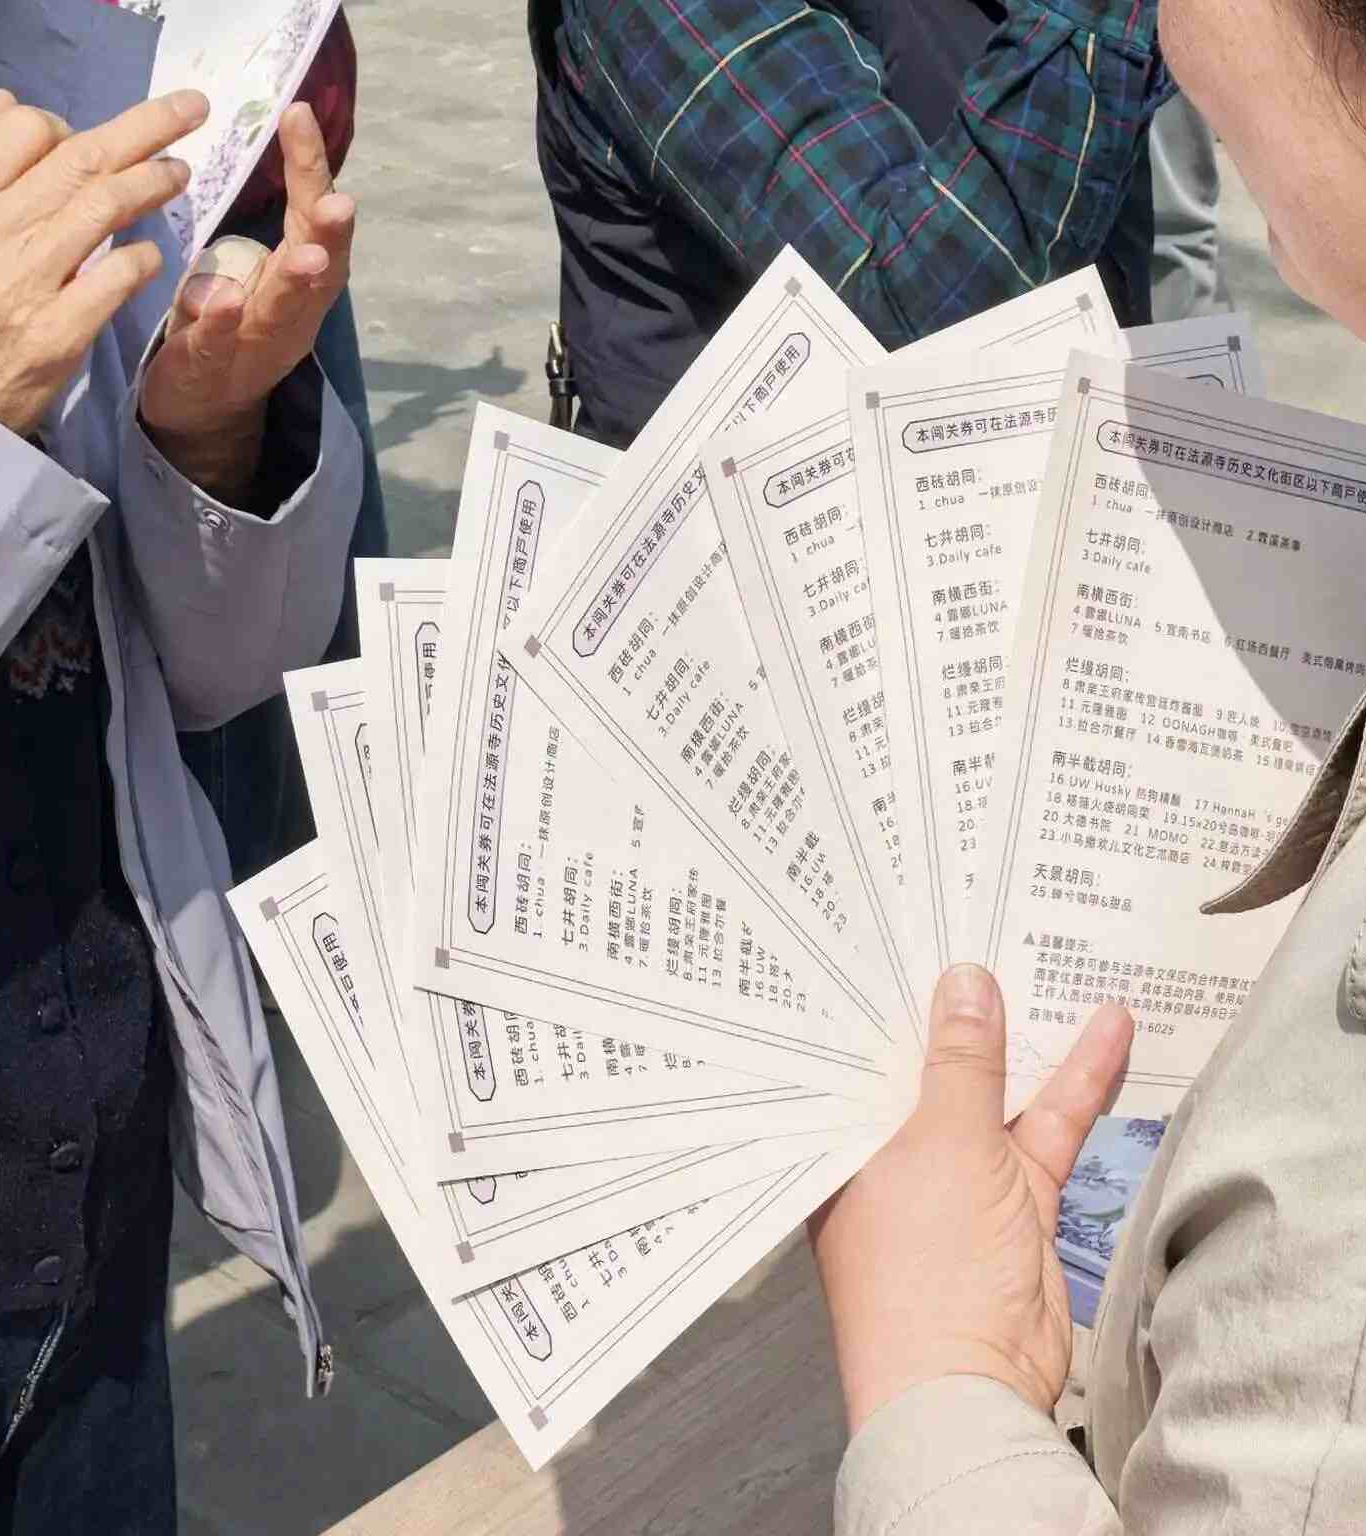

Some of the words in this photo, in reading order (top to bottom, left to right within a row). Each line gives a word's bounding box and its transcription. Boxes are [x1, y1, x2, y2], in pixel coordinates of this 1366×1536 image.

[935, 496, 964, 507] chua
[1107, 499, 1133, 513] chua
[806, 536, 834, 555] chua
[975, 544, 1003, 558] cafe
[503, 499, 536, 629] 以下商户使用
[1126, 561, 1152, 576] cafe
[633, 649, 656, 680] chua
[690, 661, 715, 688] cafe
[1146, 827, 1188, 847] MOMO
[583, 853, 593, 887] cafe
[530, 877, 545, 917] chua
[524, 1018, 539, 1063] chua
